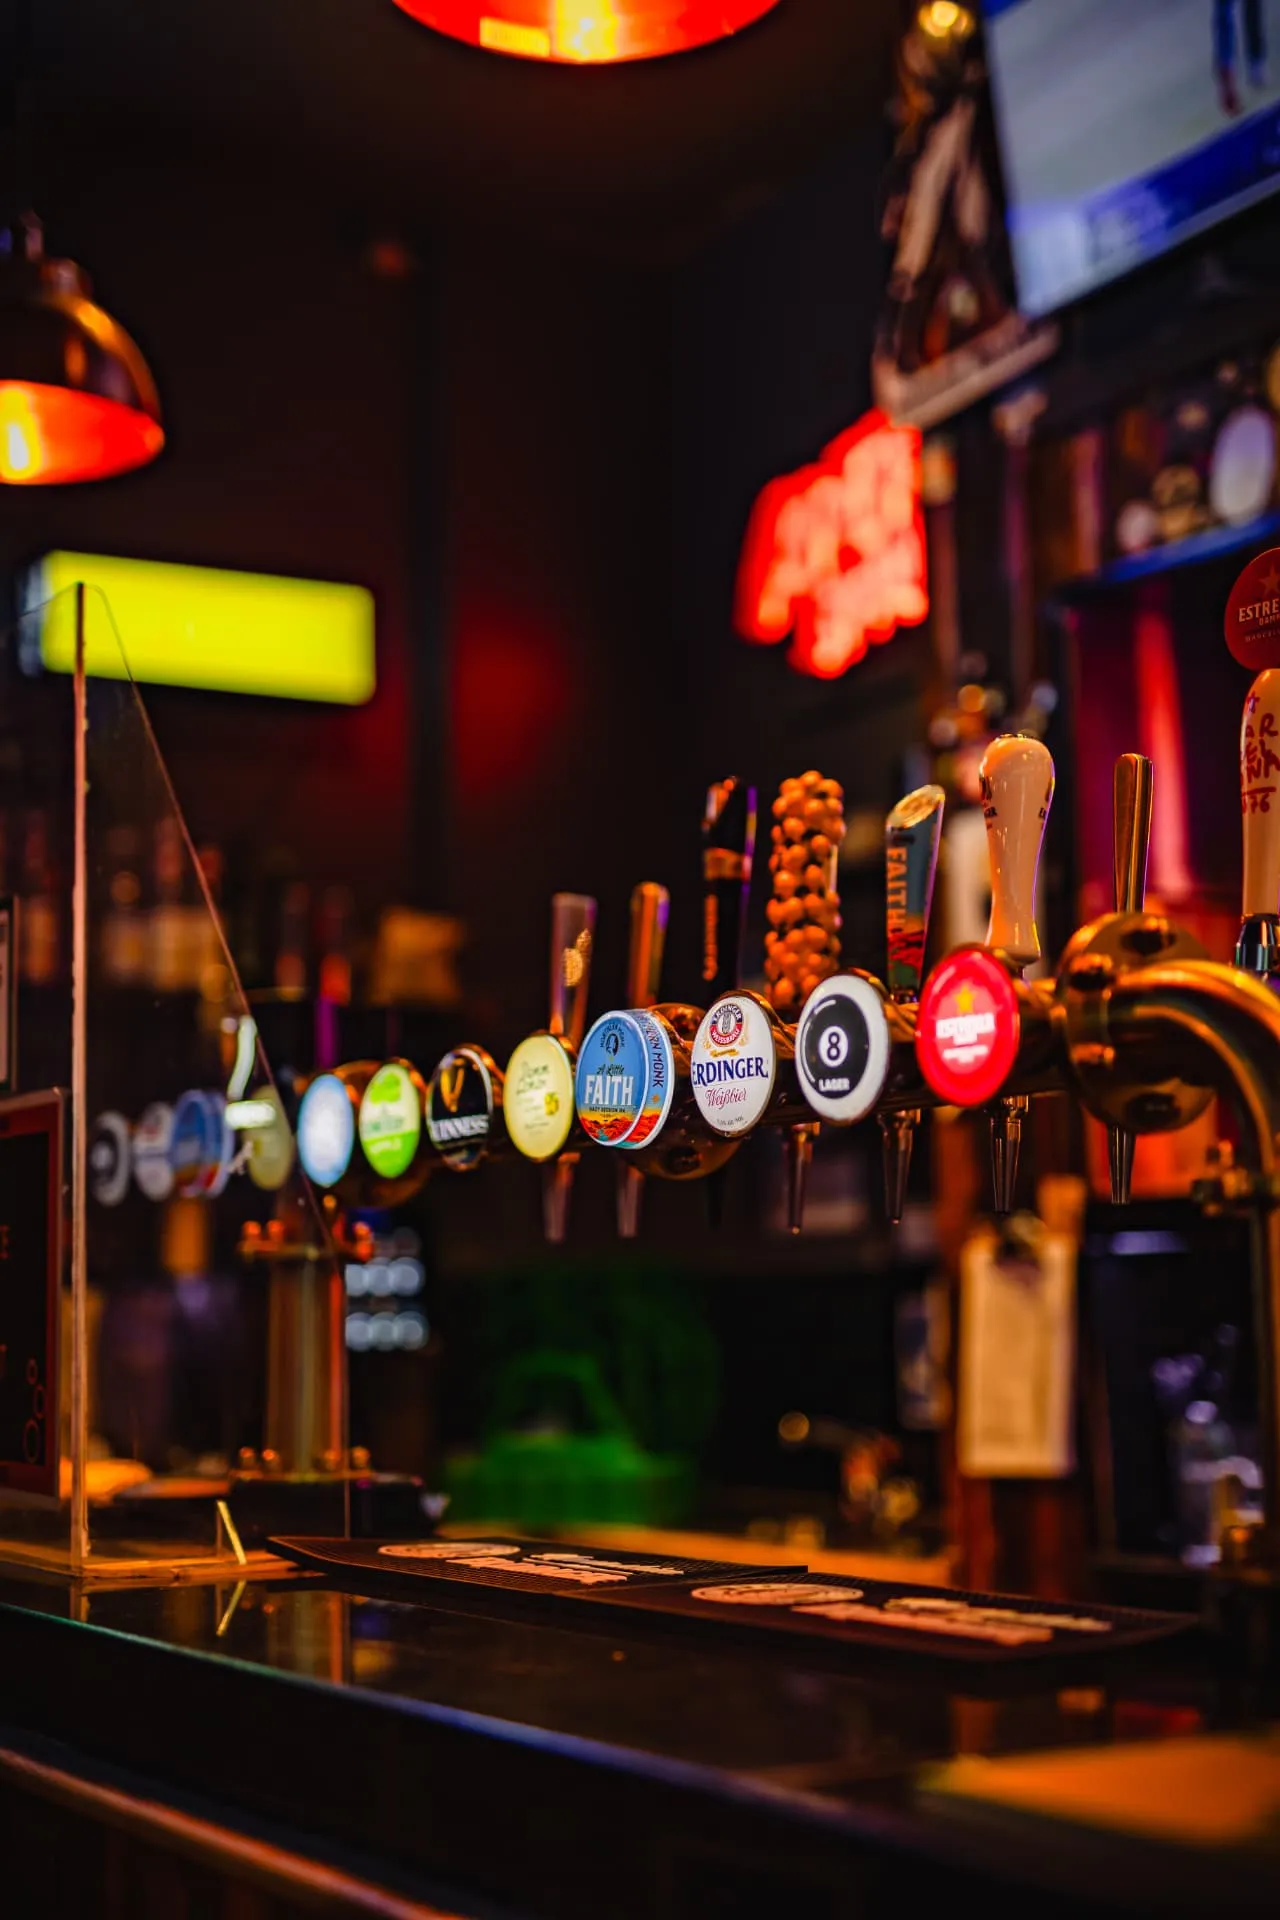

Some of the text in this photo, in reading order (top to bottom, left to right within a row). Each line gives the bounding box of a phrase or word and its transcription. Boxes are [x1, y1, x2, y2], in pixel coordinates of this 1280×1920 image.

[827, 1031, 841, 1061] 8
[652, 1052, 665, 1088] MONK
[692, 1057, 768, 1086] ERDINGER
[584, 1075, 634, 1106] FAITH
